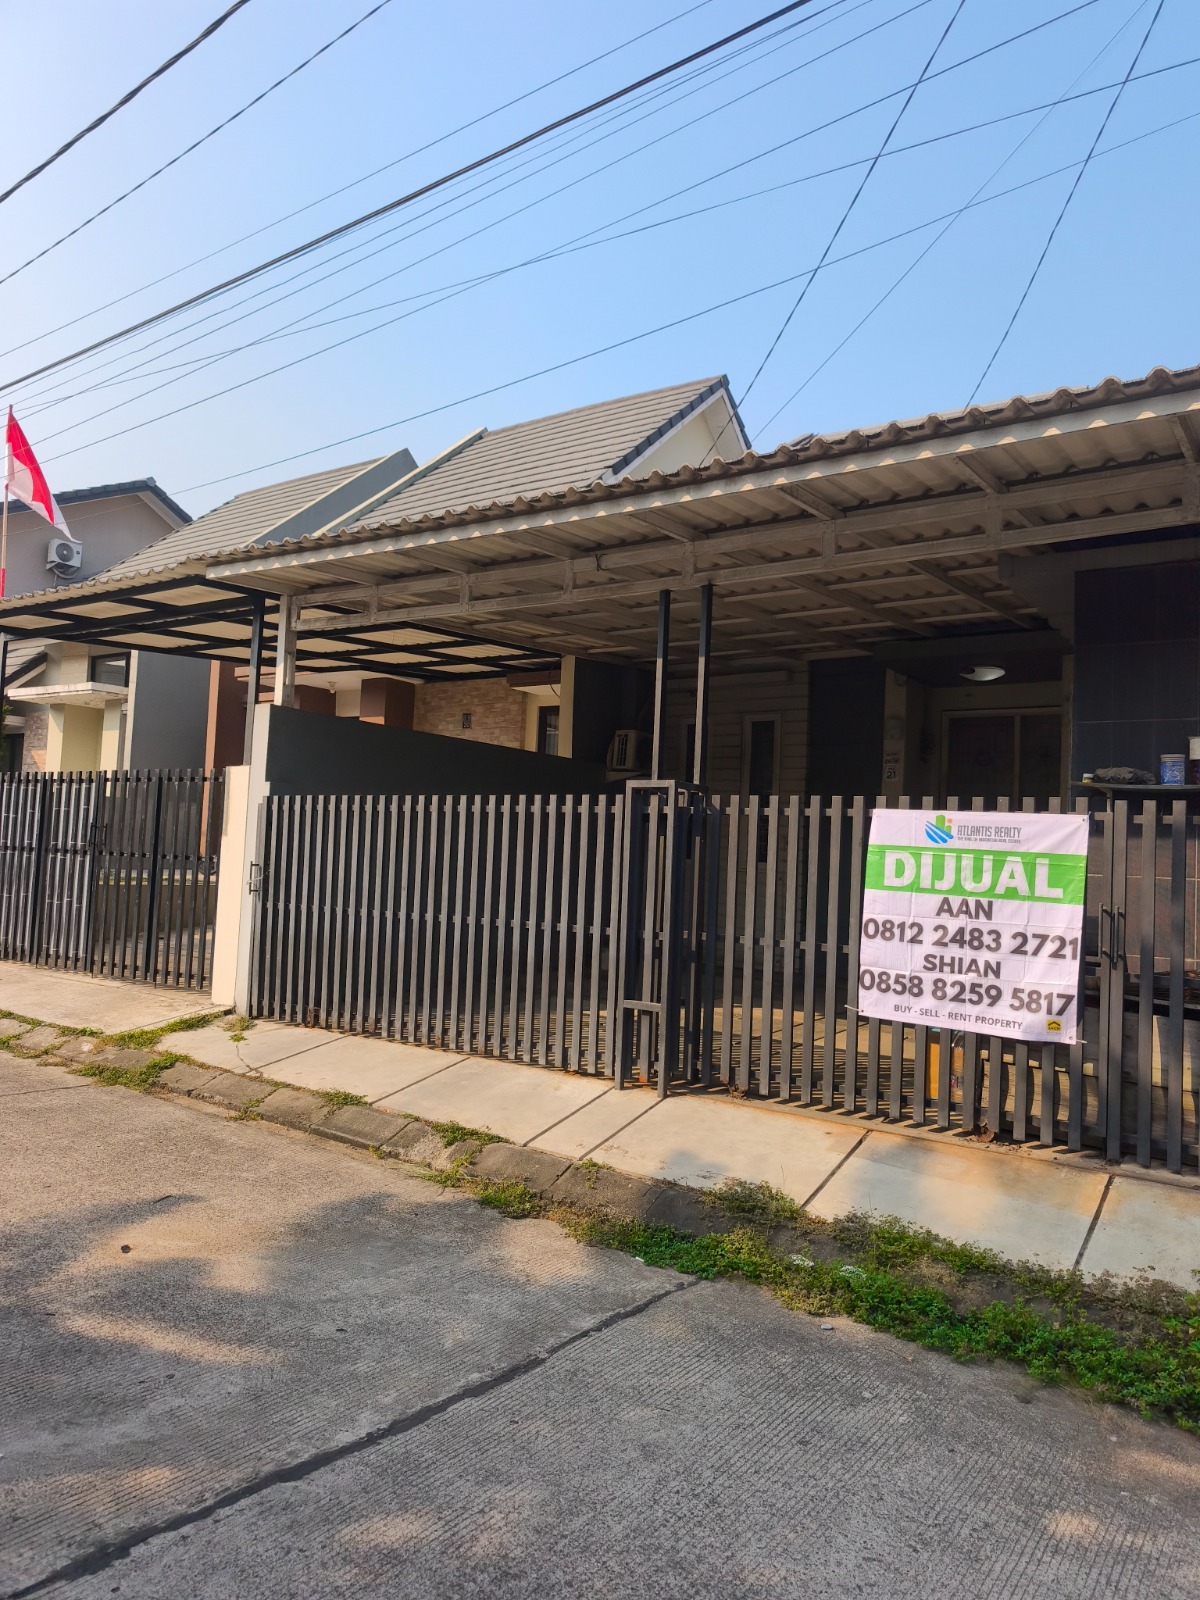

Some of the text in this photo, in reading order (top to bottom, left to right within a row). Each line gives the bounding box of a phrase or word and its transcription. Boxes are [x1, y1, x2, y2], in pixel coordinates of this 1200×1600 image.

[957, 825, 1022, 839] ATLANTIS REALTY
[884, 850, 1064, 899] DIJUAL
[936, 897, 993, 920] AAN
[863, 918, 1079, 960] 0812 2483 2721
[923, 954, 1001, 979] SHIAN
[859, 969, 1076, 1017] 0858 8259 5817
[894, 1004, 912, 1013] BUY
[920, 1008, 940, 1018] SELL
[948, 1012, 973, 1022] RENT
[975, 1015, 1023, 1030] PROPERTY
